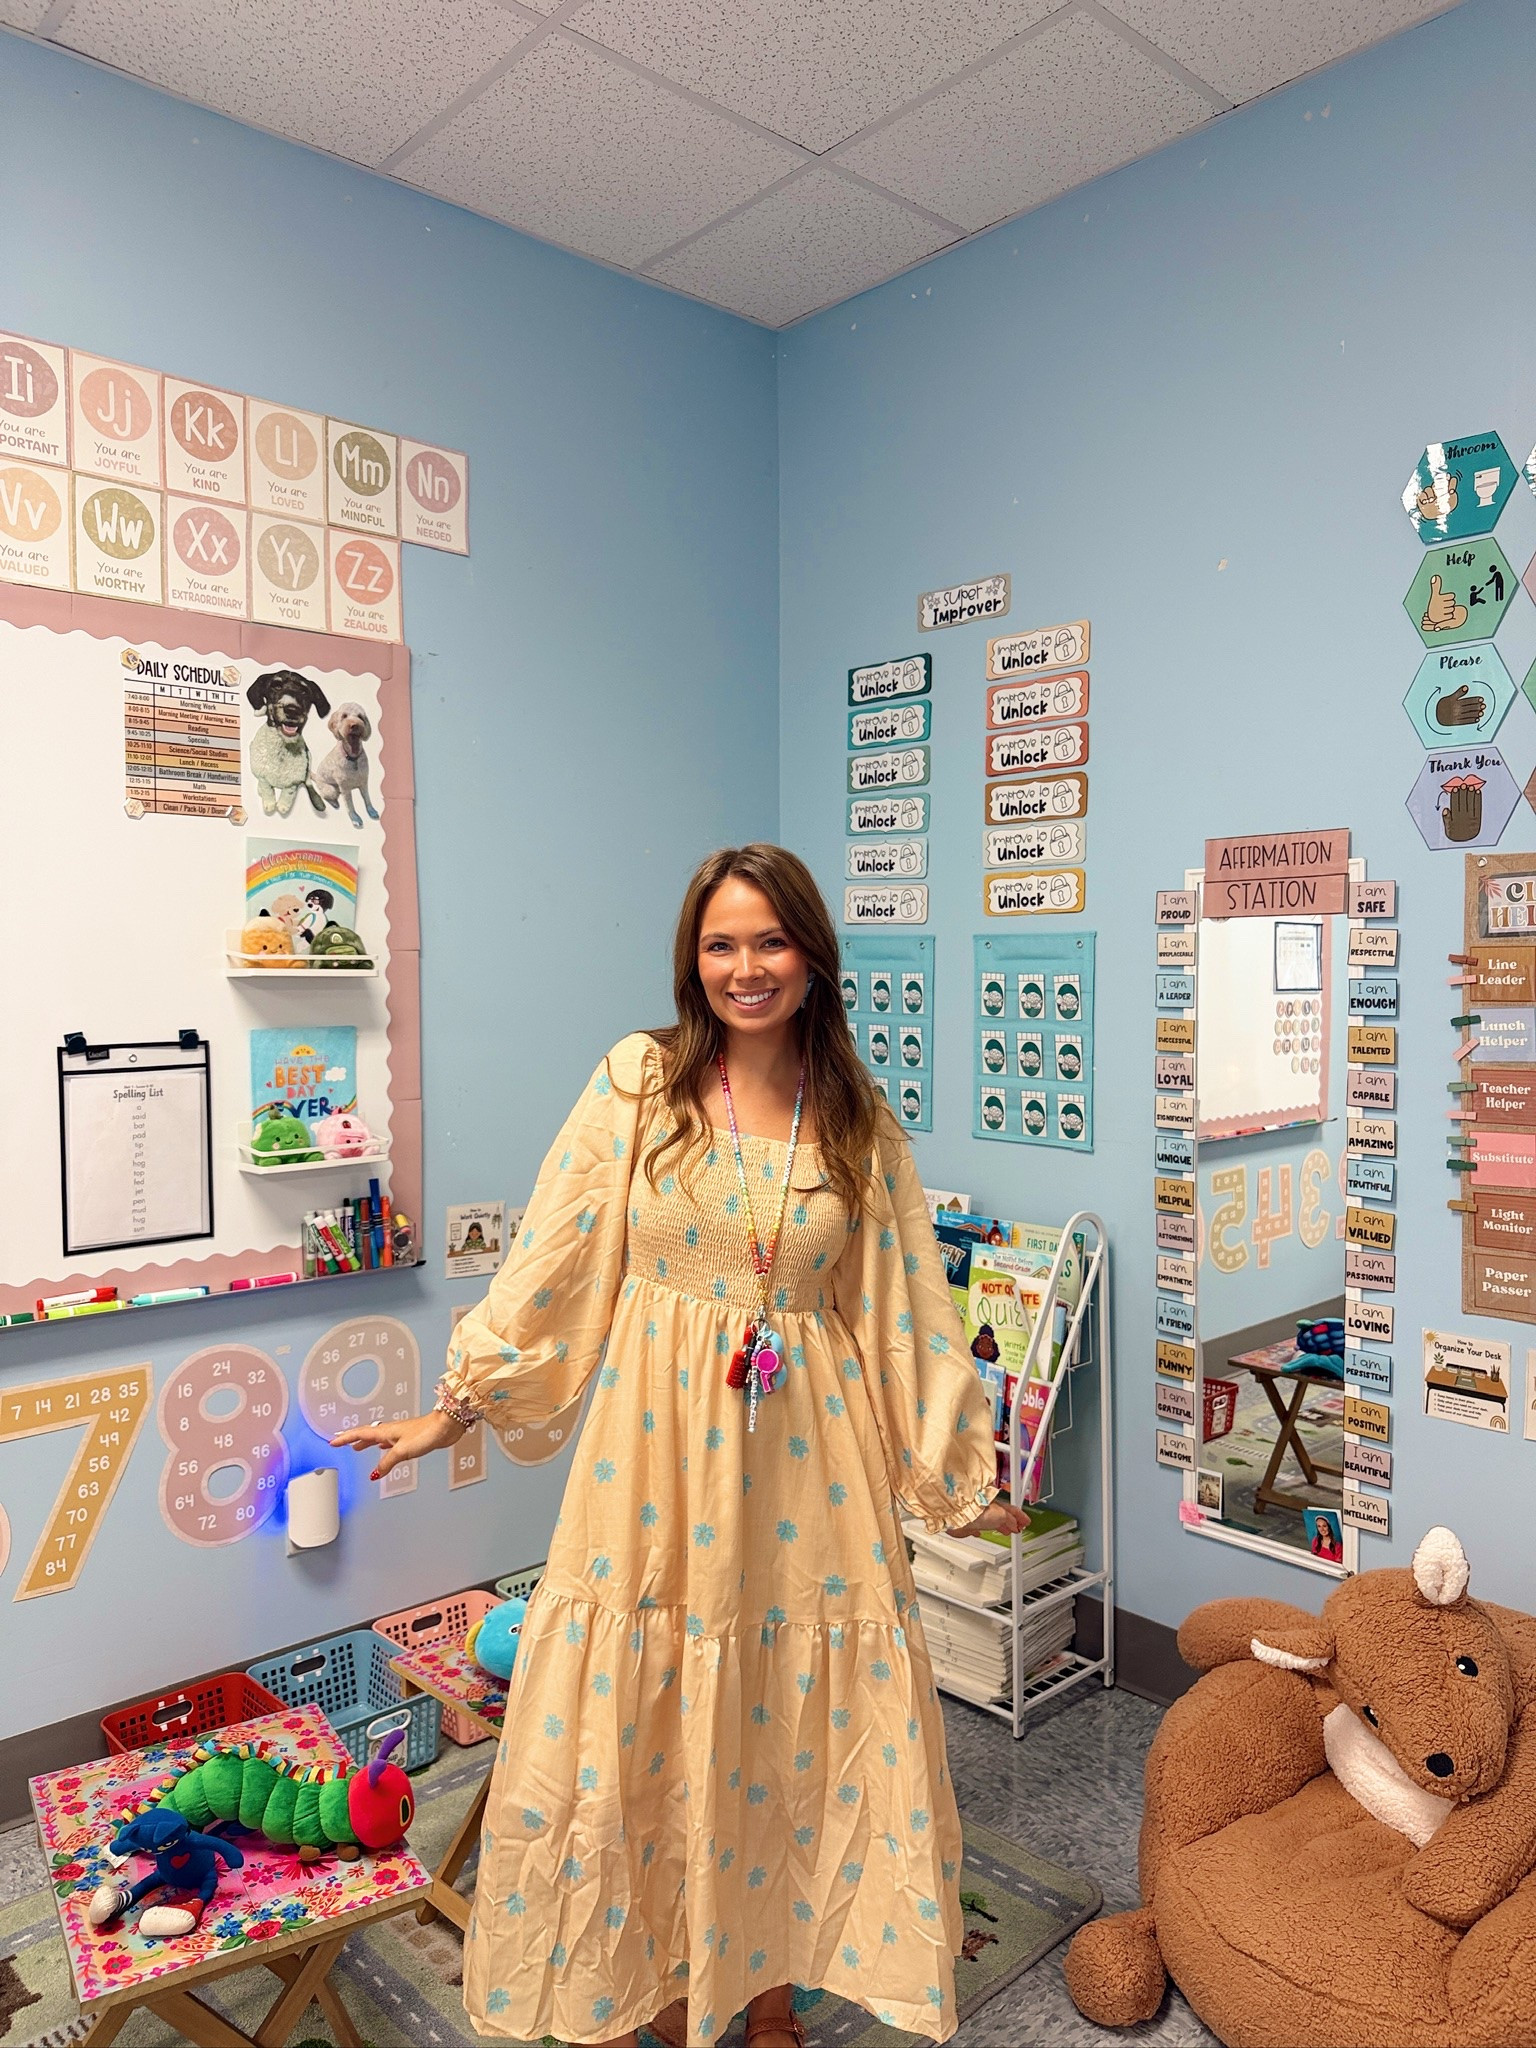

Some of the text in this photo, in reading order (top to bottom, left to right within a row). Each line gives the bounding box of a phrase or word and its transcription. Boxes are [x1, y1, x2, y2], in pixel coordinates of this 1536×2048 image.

[4, 355, 33, 404] Ii
[97, 380, 131, 437] Jj
[184, 401, 225, 450] Kk
[94, 442, 141, 460] You are
[94, 457, 141, 476] JOYFUL
[185, 462, 228, 480] You are
[341, 441, 383, 488] Mm
[193, 477, 221, 492] KIND
[418, 461, 449, 503] Nn
[0, 479, 46, 531] Vv
[271, 495, 305, 511] LOVED
[93, 498, 143, 550] Ww
[340, 509, 385, 528] MINDFUL
[187, 518, 229, 565] Xx
[416, 526, 452, 543] NEEDED
[270, 535, 305, 588] Yy
[1446, 551, 1476, 566] Help
[0, 559, 49, 577] VALUED
[345, 550, 385, 593] Zz
[94, 575, 145, 593] WORTHY
[171, 589, 243, 610] EXTRAORDINARY
[279, 607, 300, 619] YOU
[933, 599, 1001, 625] Improver
[344, 618, 388, 634] ZEALOUS
[1001, 650, 1049, 670] Unlock
[1439, 655, 1483, 670] Please
[137, 659, 168, 678] DAILY
[860, 679, 899, 698] Unlock
[180, 701, 202, 710] Morning
[1000, 701, 1048, 721] Unlock
[187, 724, 209, 734] Reading
[859, 725, 898, 742] Unlock
[187, 736, 210, 745] Specials
[169, 746, 228, 758] Science/Social Studies
[1000, 749, 1048, 767] Unlock
[1429, 755, 1503, 774] Thank You
[859, 769, 898, 786] Unlock
[183, 793, 217, 802] Workstations
[999, 799, 1047, 817] Unlock
[858, 815, 897, 829] Unlock
[997, 844, 1045, 861] Unlock
[1219, 840, 1332, 871] AFFIRMATION
[857, 860, 895, 873] Unlock
[998, 892, 1045, 909] Unlock
[1226, 880, 1317, 911] STATION
[856, 904, 896, 918] Unlock
[1160, 909, 1191, 920] PROUD
[1357, 900, 1386, 914] SAFE
[1350, 948, 1396, 958] RESPECTFUL
[1488, 959, 1517, 970] Line
[1479, 974, 1526, 985] Leader
[1166, 992, 1191, 1001] LEADER
[1350, 998, 1396, 1009] ENOUGH
[1480, 1020, 1525, 1031] Lunch
[1158, 1036, 1192, 1045] SUCCESSFUL
[1479, 1036, 1528, 1049] Helper
[1351, 1046, 1391, 1056] TALENTED
[275, 1064, 325, 1088] BEST
[1157, 1073, 1194, 1087] LOYAL
[113, 1088, 164, 1102] Spelling List
[287, 1085, 317, 1099] DAY
[1480, 1082, 1531, 1095] Teacher
[1352, 1091, 1390, 1103] CAPABLE
[1485, 1096, 1526, 1112] Helper
[1157, 1113, 1193, 1124] SIGNIFICANT
[1348, 1137, 1394, 1151] AMAZING
[1157, 1153, 1192, 1166] UNIQUE
[1472, 1151, 1534, 1165] Substitute
[1347, 1179, 1392, 1193] TRUTHFUL
[1158, 1195, 1192, 1208] HELPFUL
[1491, 1209, 1524, 1221] Light
[1348, 1227, 1391, 1244] VALUED
[1482, 1220, 1533, 1235] Monitor
[1027, 1238, 1047, 1250] FIRST
[1157, 1274, 1193, 1287] EMPATHETIC
[1346, 1271, 1394, 1284] PASSIONATE
[1485, 1267, 1529, 1282] Paper
[982, 1283, 1002, 1294] NOT
[1482, 1282, 1532, 1297] Passer
[1166, 1317, 1192, 1332] FRIEND
[1348, 1317, 1390, 1335] LOVING
[348, 1332, 366, 1349] 27
[375, 1332, 389, 1346] 18
[322, 1348, 340, 1364] 36
[1434, 1341, 1502, 1360] Organize Your Desk
[212, 1360, 232, 1377] 24
[1158, 1358, 1193, 1376] FUNNY
[1346, 1367, 1389, 1383] PERSISTENT
[247, 1370, 266, 1385] 32
[311, 1376, 329, 1391] 45
[178, 1383, 193, 1399] 16
[395, 1381, 408, 1396] 81
[11, 1381, 139, 1420] 7 14 21 28 35
[109, 1408, 130, 1424] 42
[252, 1403, 272, 1418] 40
[319, 1402, 337, 1418] 54
[368, 1406, 385, 1421] 72
[1158, 1403, 1193, 1419] GRATEFUL
[179, 1417, 190, 1432] 8
[342, 1413, 360, 1428] 63
[1348, 1417, 1386, 1435] POSITIVE
[100, 1432, 120, 1448] 49
[214, 1433, 234, 1449] 48
[504, 1428, 524, 1443] 100
[548, 1429, 563, 1442] 90
[252, 1443, 271, 1459] 96
[1159, 1448, 1192, 1464] AWESOME
[89, 1456, 110, 1472] 56
[178, 1460, 199, 1476] 56
[459, 1456, 476, 1471] 50
[1344, 1461, 1390, 1480] BEAUTIFUL
[78, 1482, 100, 1499] 63
[257, 1475, 277, 1491] 88
[175, 1493, 195, 1510] 64
[66, 1507, 88, 1525] 70
[235, 1505, 255, 1521] 80
[1344, 1508, 1388, 1527] INTELLIGENT
[198, 1514, 217, 1531] 72
[55, 1534, 77, 1551] 77
[45, 1558, 66, 1576] 84
